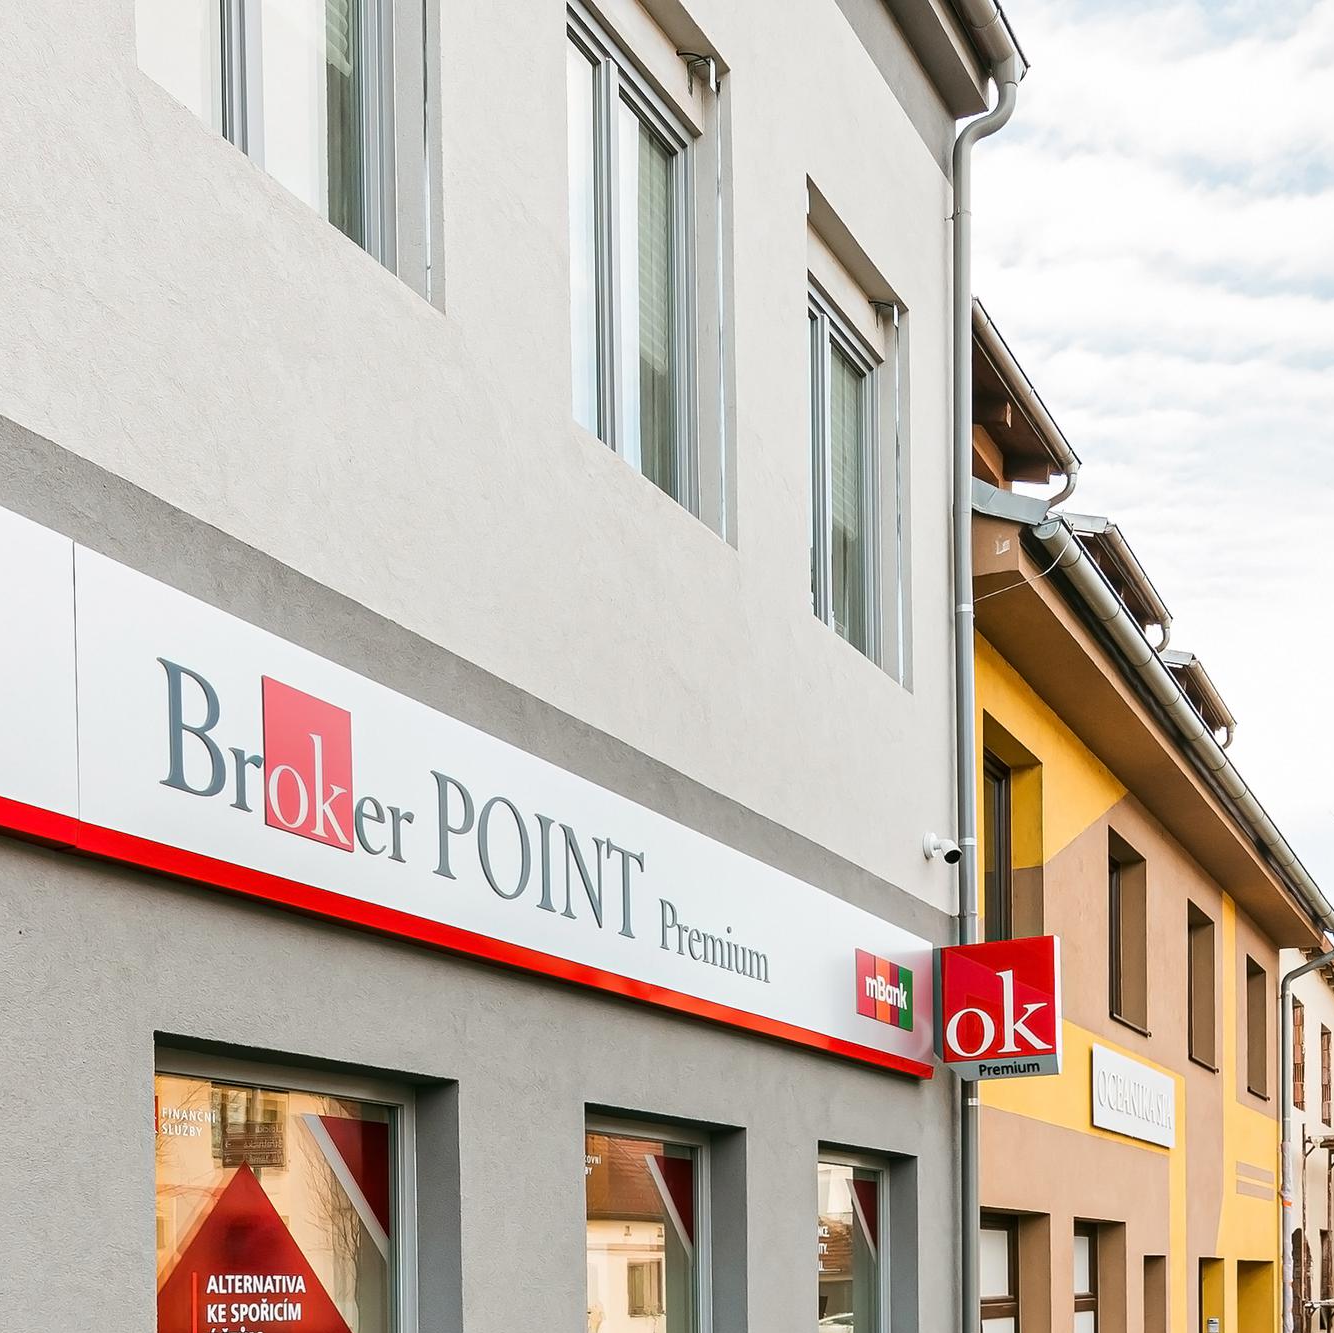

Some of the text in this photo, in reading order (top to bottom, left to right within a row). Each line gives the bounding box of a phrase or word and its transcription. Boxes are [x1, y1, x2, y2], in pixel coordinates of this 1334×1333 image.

[157, 656, 771, 984] Broker POINT Premium
[865, 975, 908, 1010] mBank
[946, 970, 1052, 1058] ok
[978, 1061, 1040, 1077] Premium
[161, 1107, 216, 1123] FINANČNÍ
[161, 1122, 203, 1137] SLUŽBY
[206, 1273, 306, 1295] ALTERNATIVA
[206, 1297, 303, 1323] KE SPOŘICÍM
